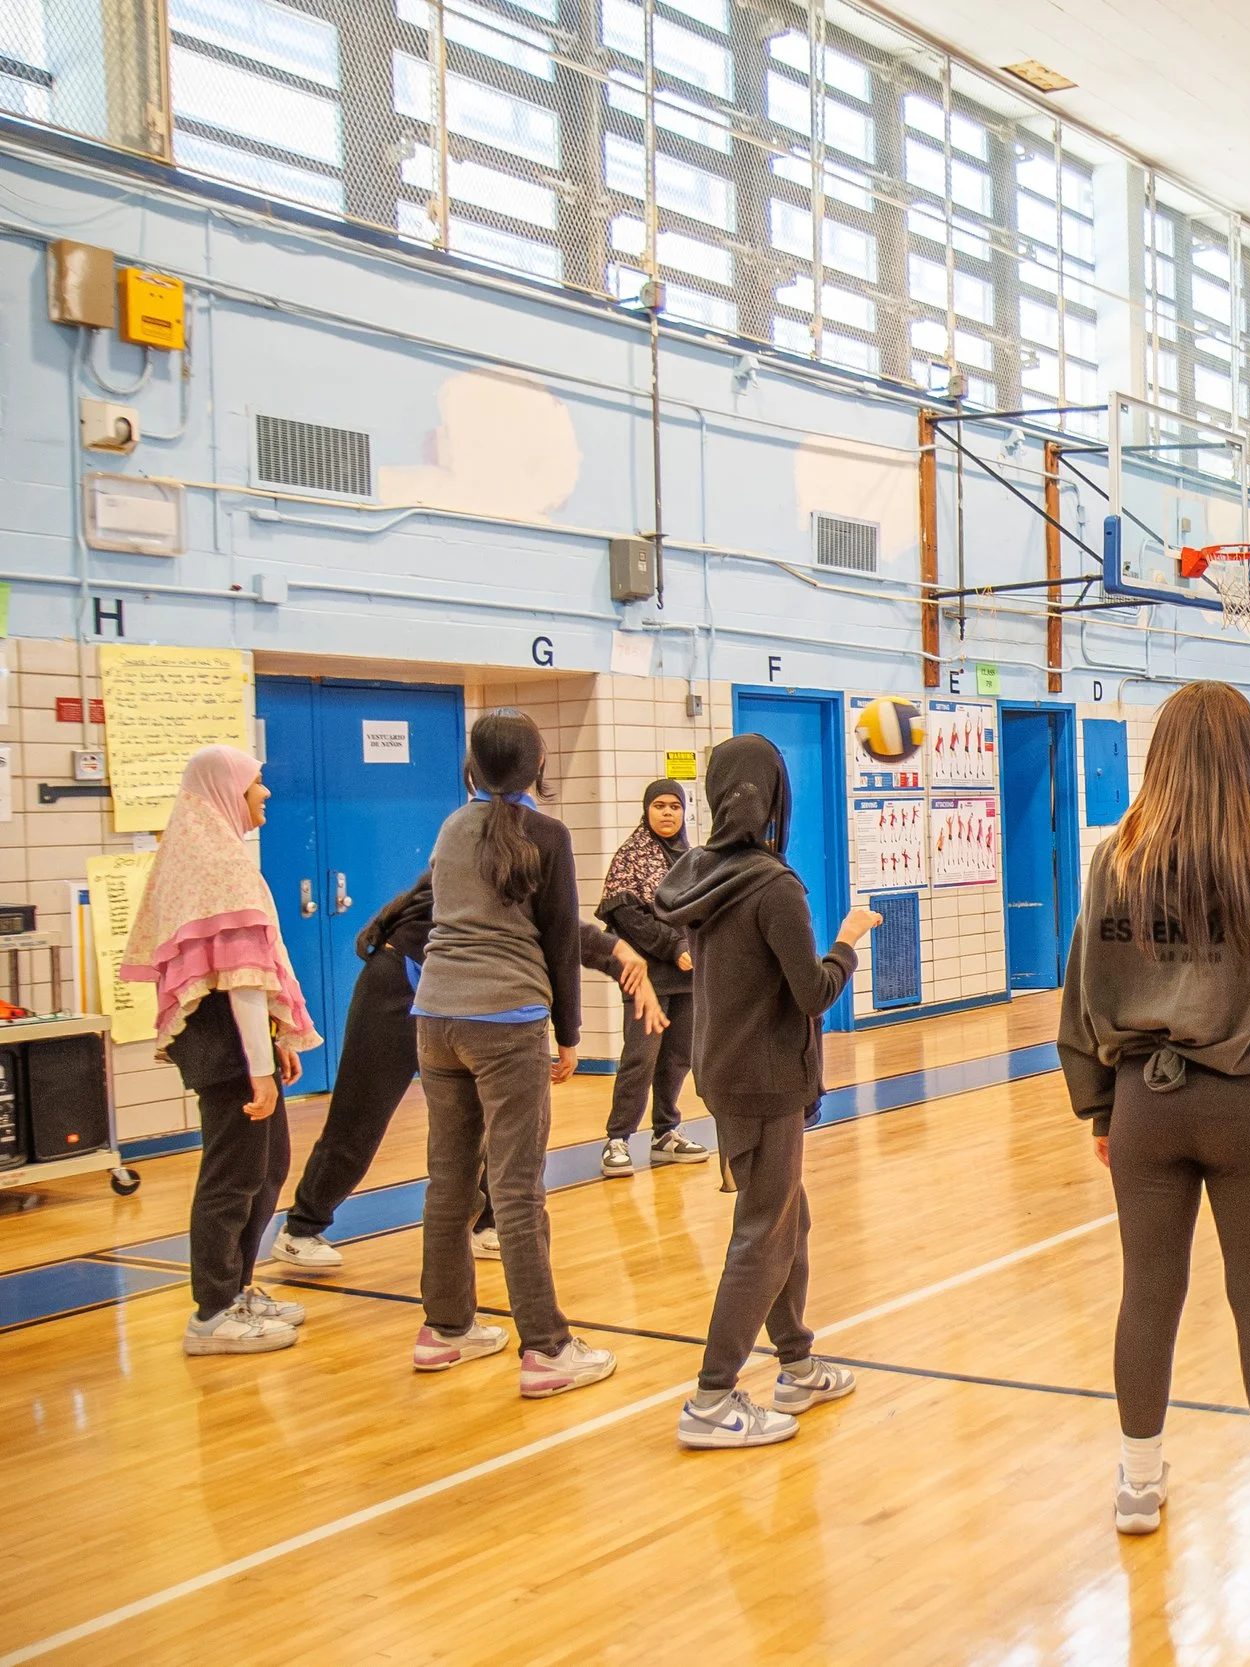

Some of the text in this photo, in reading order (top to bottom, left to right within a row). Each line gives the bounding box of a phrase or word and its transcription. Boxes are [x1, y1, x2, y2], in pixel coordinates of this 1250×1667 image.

[94, 597, 125, 637] H
[531, 636, 555, 667] G
[768, 656, 782, 682] F
[950, 670, 960, 694] E
[1093, 681, 1103, 701] D
